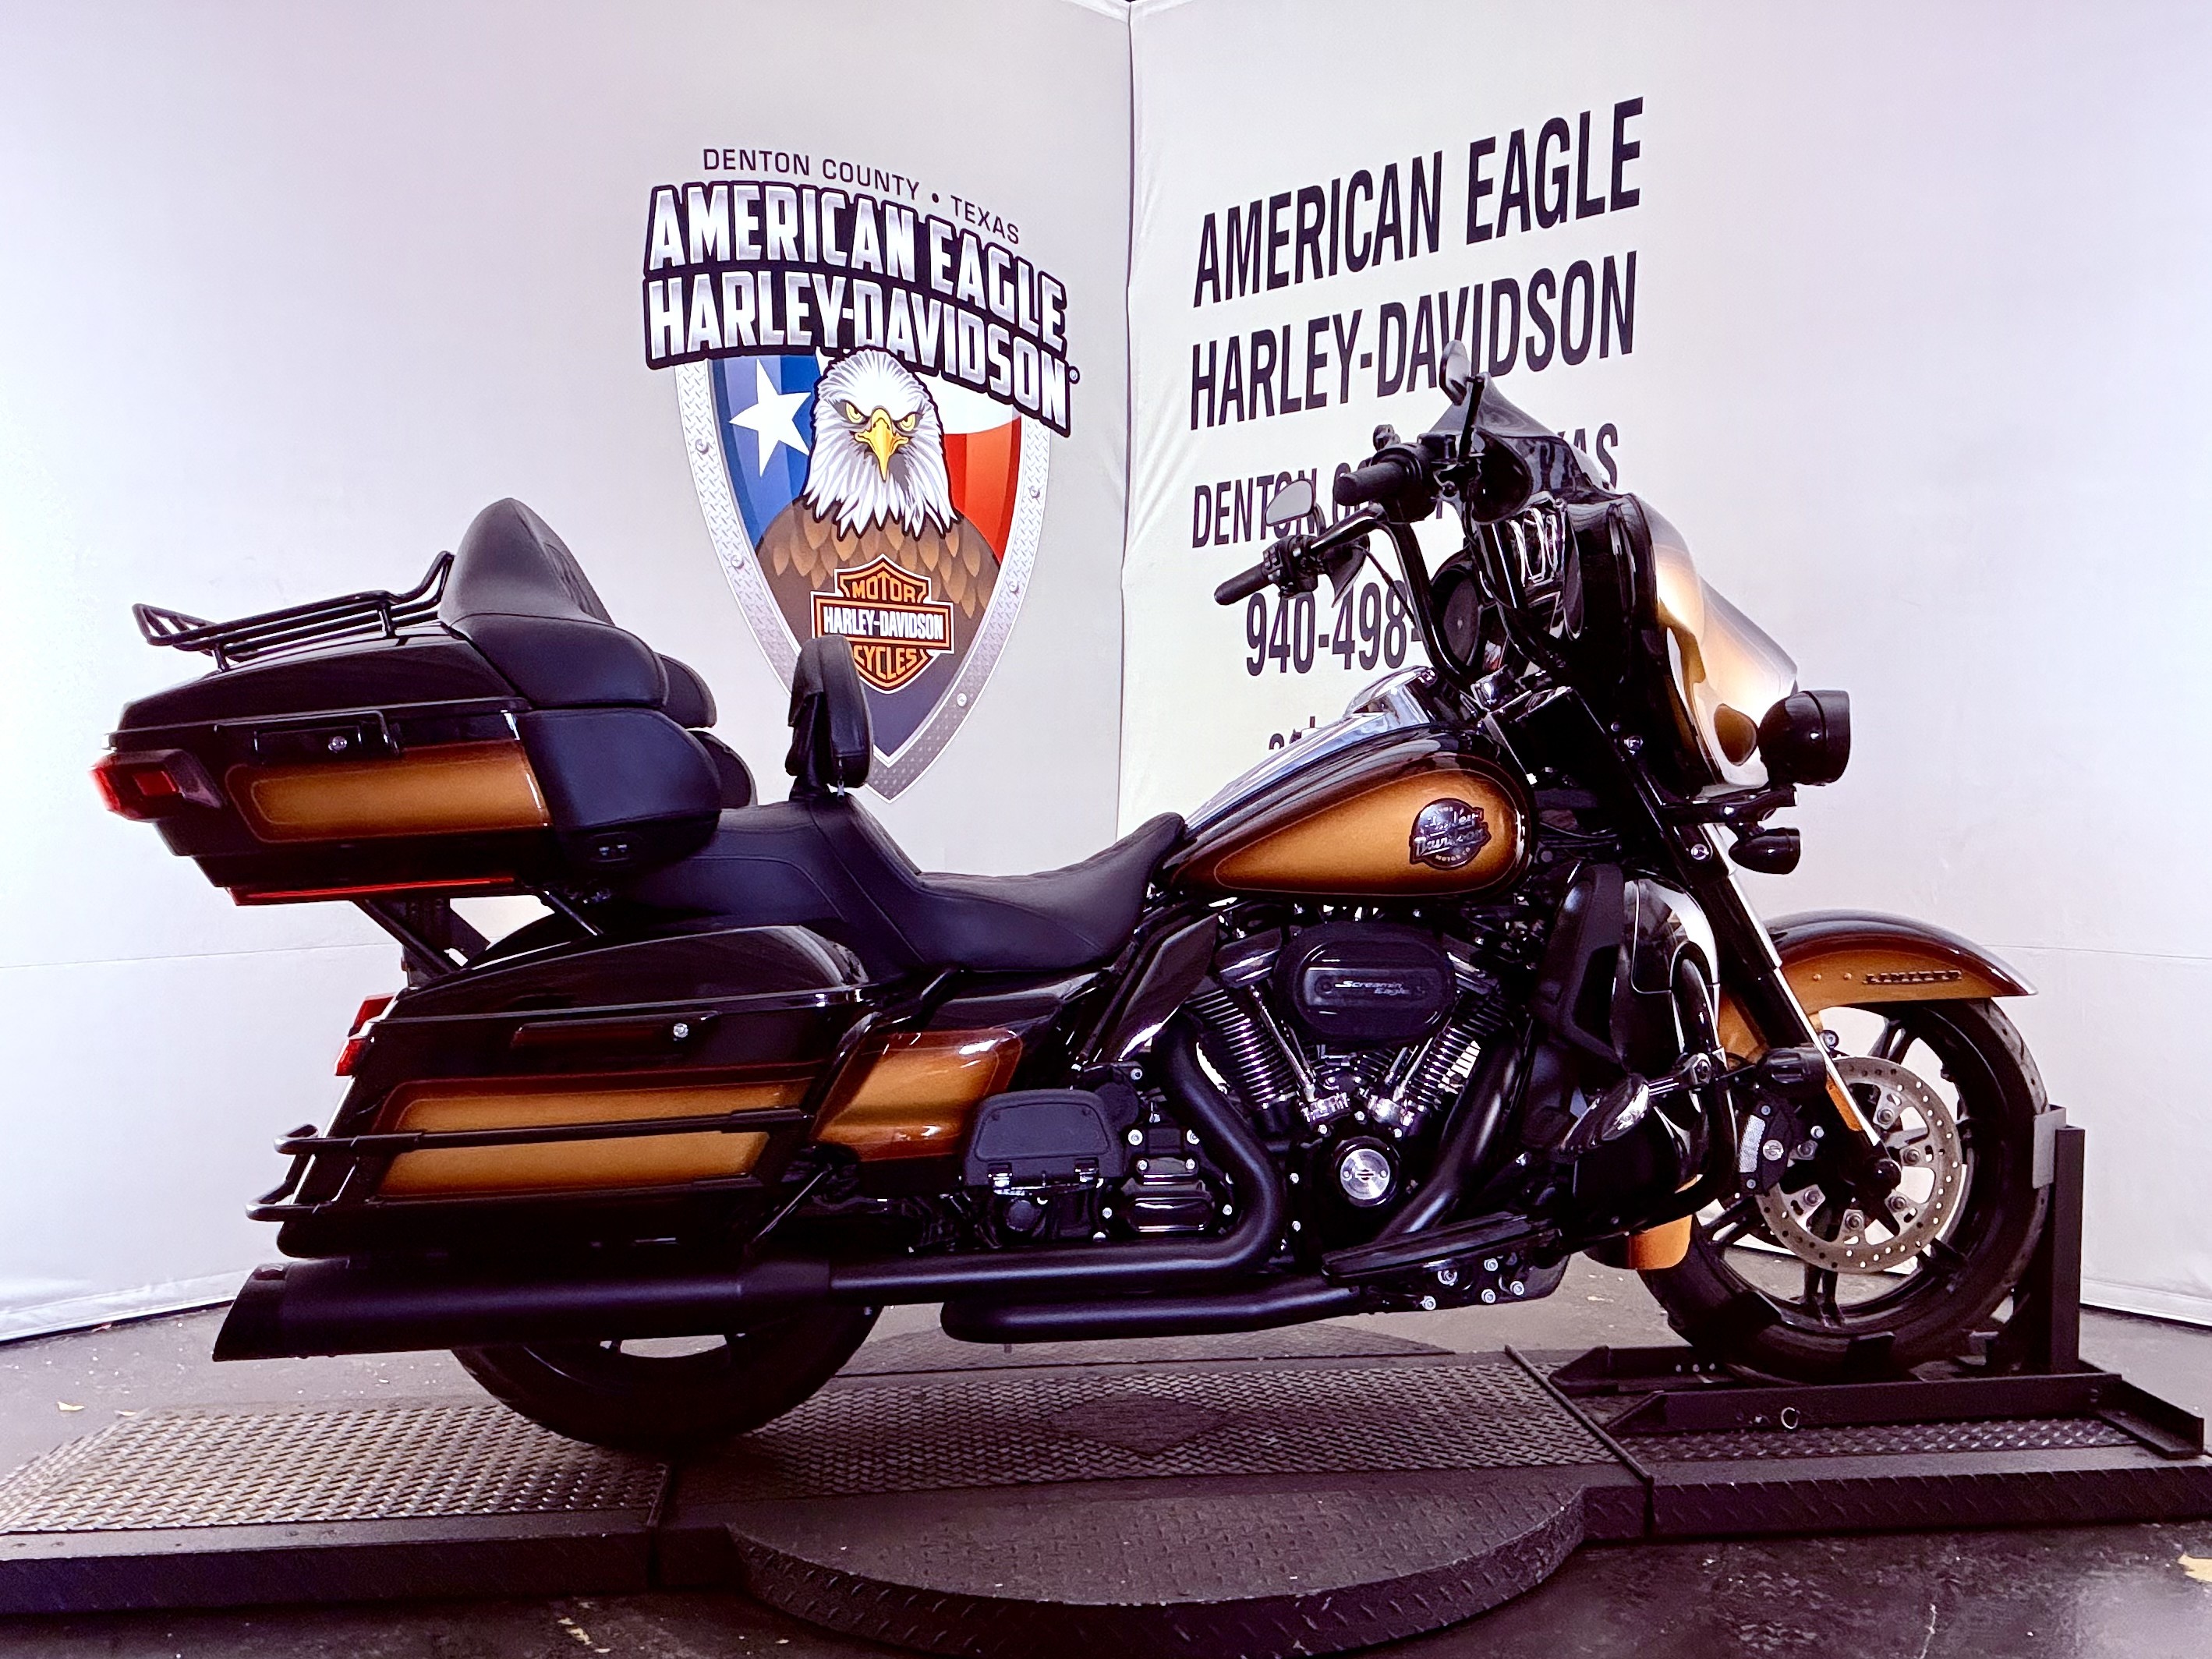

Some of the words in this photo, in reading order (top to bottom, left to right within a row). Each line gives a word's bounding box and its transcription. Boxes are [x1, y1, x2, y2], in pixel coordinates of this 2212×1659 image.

[703, 148, 809, 176] DENTON
[822, 158, 921, 200] COUNTY
[950, 193, 1020, 245] TEXAS
[1193, 150, 1442, 309] AMERICAN
[1466, 96, 1644, 246] EAGLE
[649, 184, 916, 282] AMERICAN
[929, 221, 1064, 348] EAGLE
[648, 271, 1070, 427] HARLEY-DAVIDSON
[1191, 250, 1637, 431] HARLEY-DAVIDSON
[823, 606, 944, 640] HARLEY-DAVIDSON
[851, 571, 917, 603] MOTOR
[853, 645, 918, 680] CYCLES
